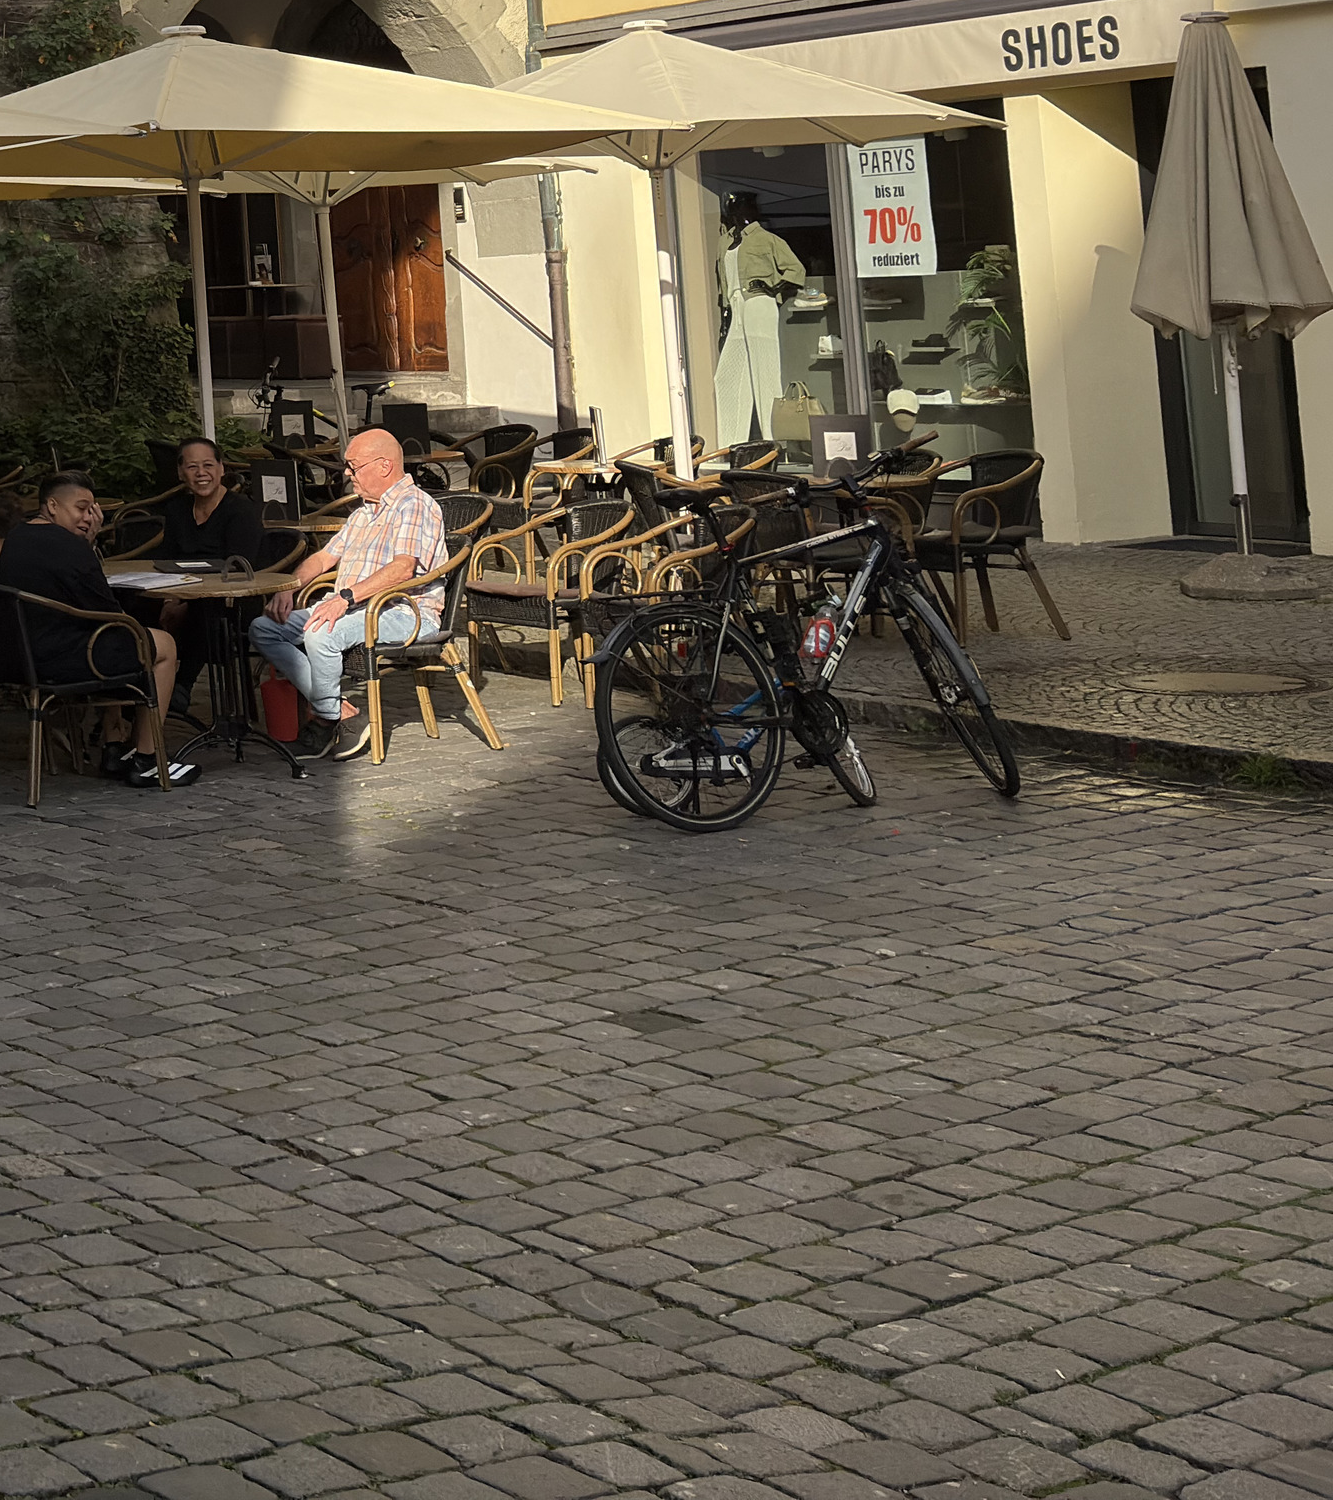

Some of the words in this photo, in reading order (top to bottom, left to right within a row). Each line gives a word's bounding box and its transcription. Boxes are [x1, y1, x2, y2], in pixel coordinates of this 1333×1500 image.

[1002, 15, 1121, 72] SHOES
[859, 148, 915, 174] PARYS
[875, 185, 892, 198] bis
[893, 185, 905, 198] zu
[863, 205, 922, 244] 70%
[873, 253, 921, 267] reduziert
[821, 595, 867, 682] BULLS
